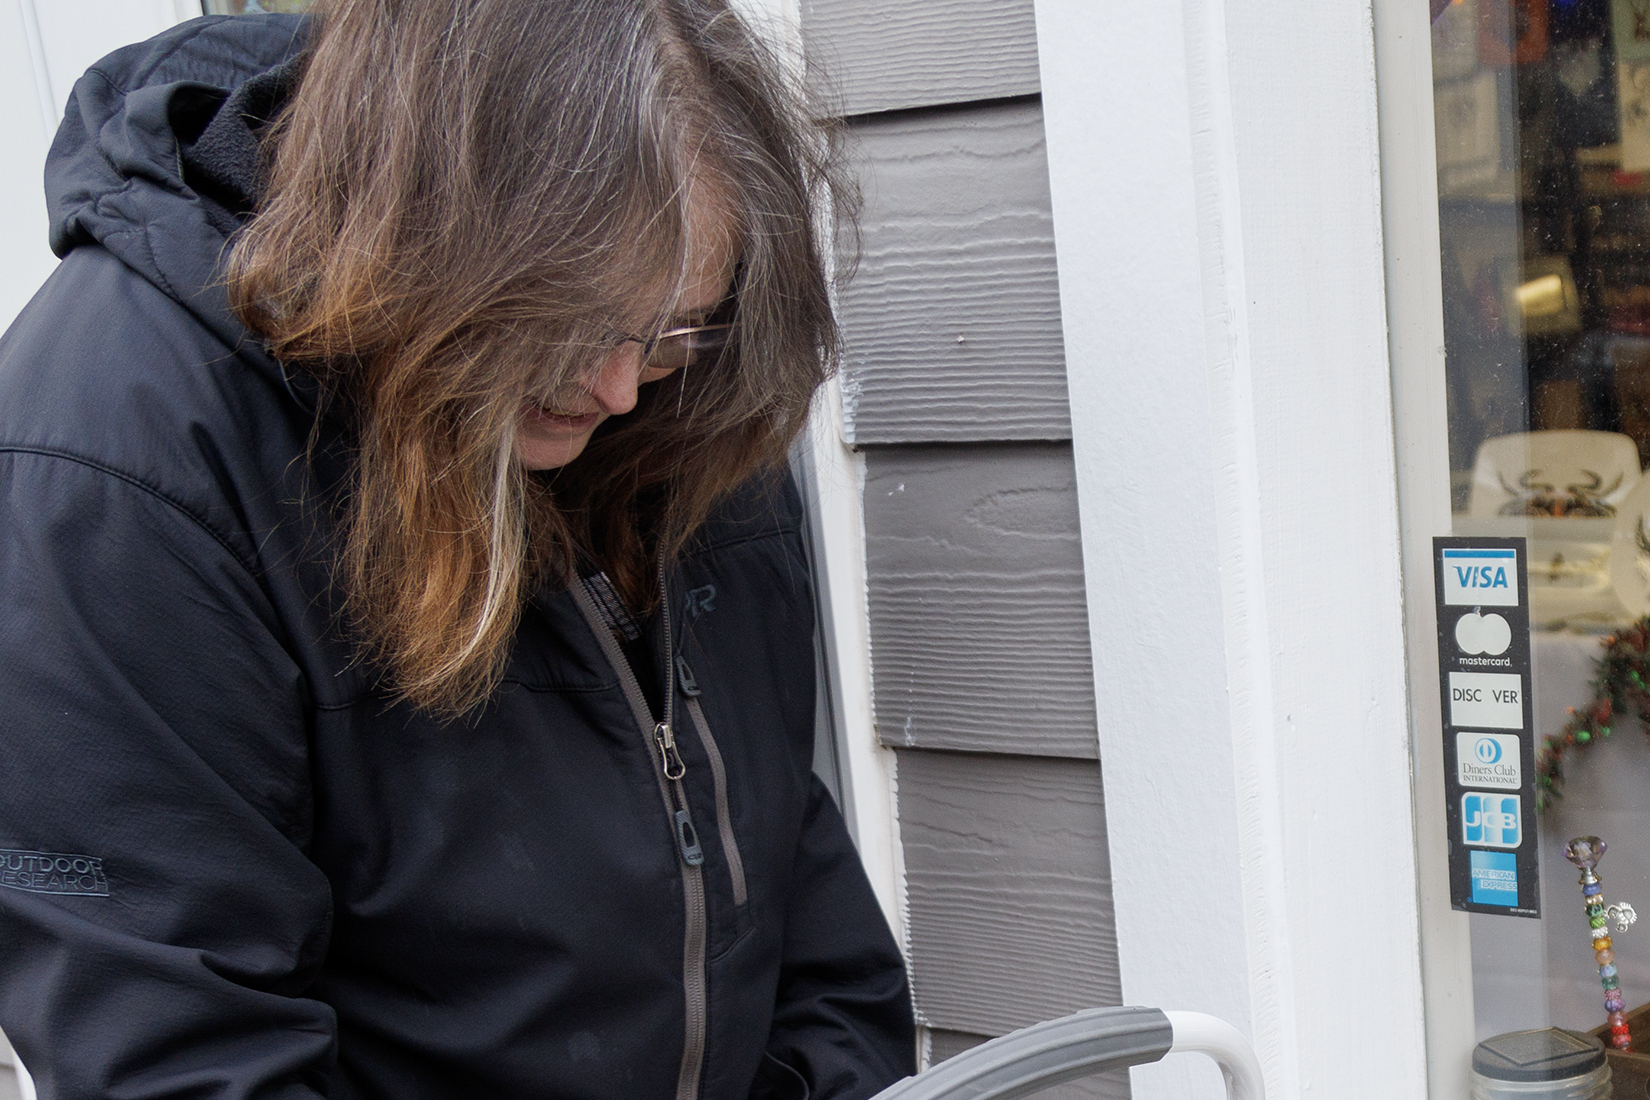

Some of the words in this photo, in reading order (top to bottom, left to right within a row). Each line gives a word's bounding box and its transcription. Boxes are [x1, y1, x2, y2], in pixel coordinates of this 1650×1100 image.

[1452, 566, 1508, 588] VISA
[1459, 657, 1512, 667] mastercard
[1453, 688, 1519, 704] DISCVER
[1463, 763, 1492, 775] Diners
[1494, 766, 1516, 776] Club
[1463, 775, 1517, 785] INTERNATIONAL
[1466, 811, 1516, 829] JCB
[1, 870, 108, 892] ESEARCH
[1482, 881, 1518, 890] EXPRESS
